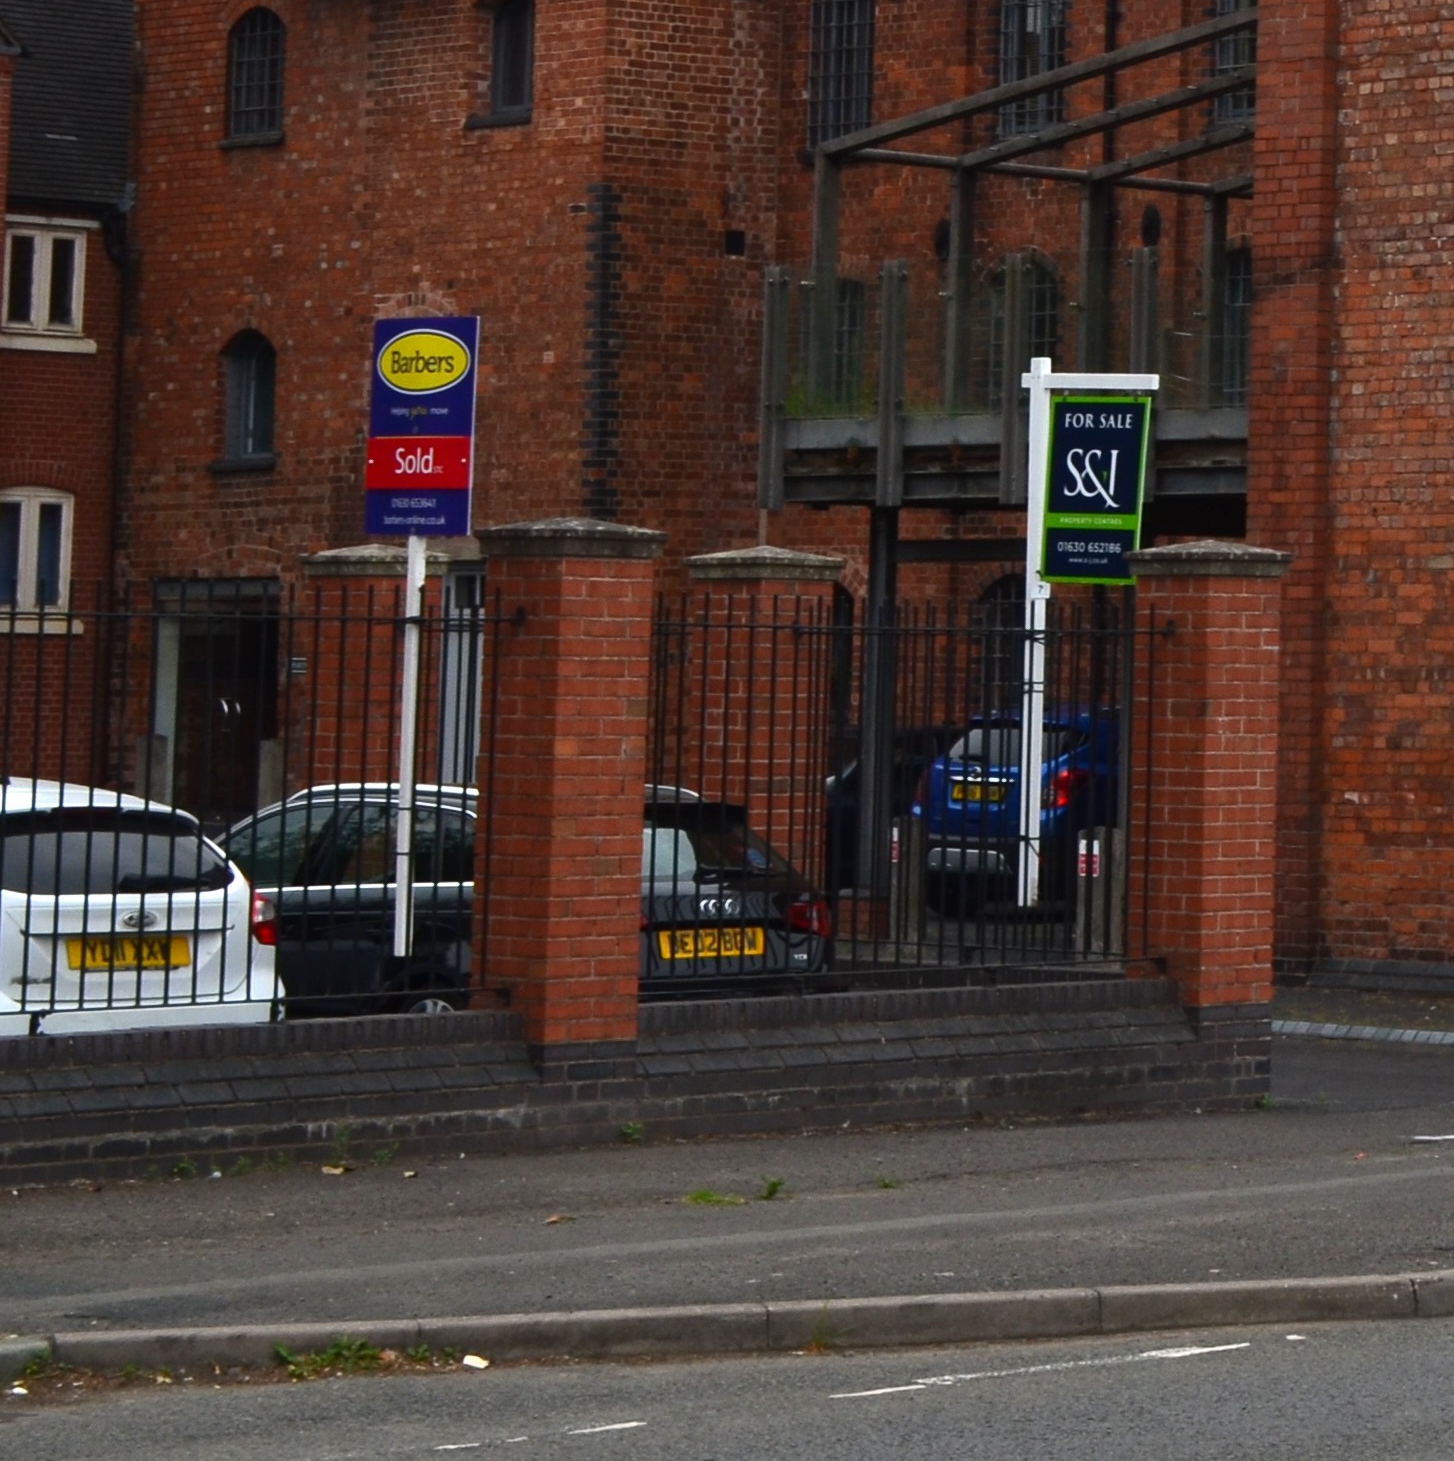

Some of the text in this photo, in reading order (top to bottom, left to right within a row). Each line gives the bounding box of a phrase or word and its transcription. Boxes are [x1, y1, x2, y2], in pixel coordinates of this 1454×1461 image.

[391, 350, 454, 375] Barbers
[1064, 413, 1133, 429] FOR SALE
[394, 447, 434, 474] Sold
[1057, 541, 1121, 554] 01630 652186
